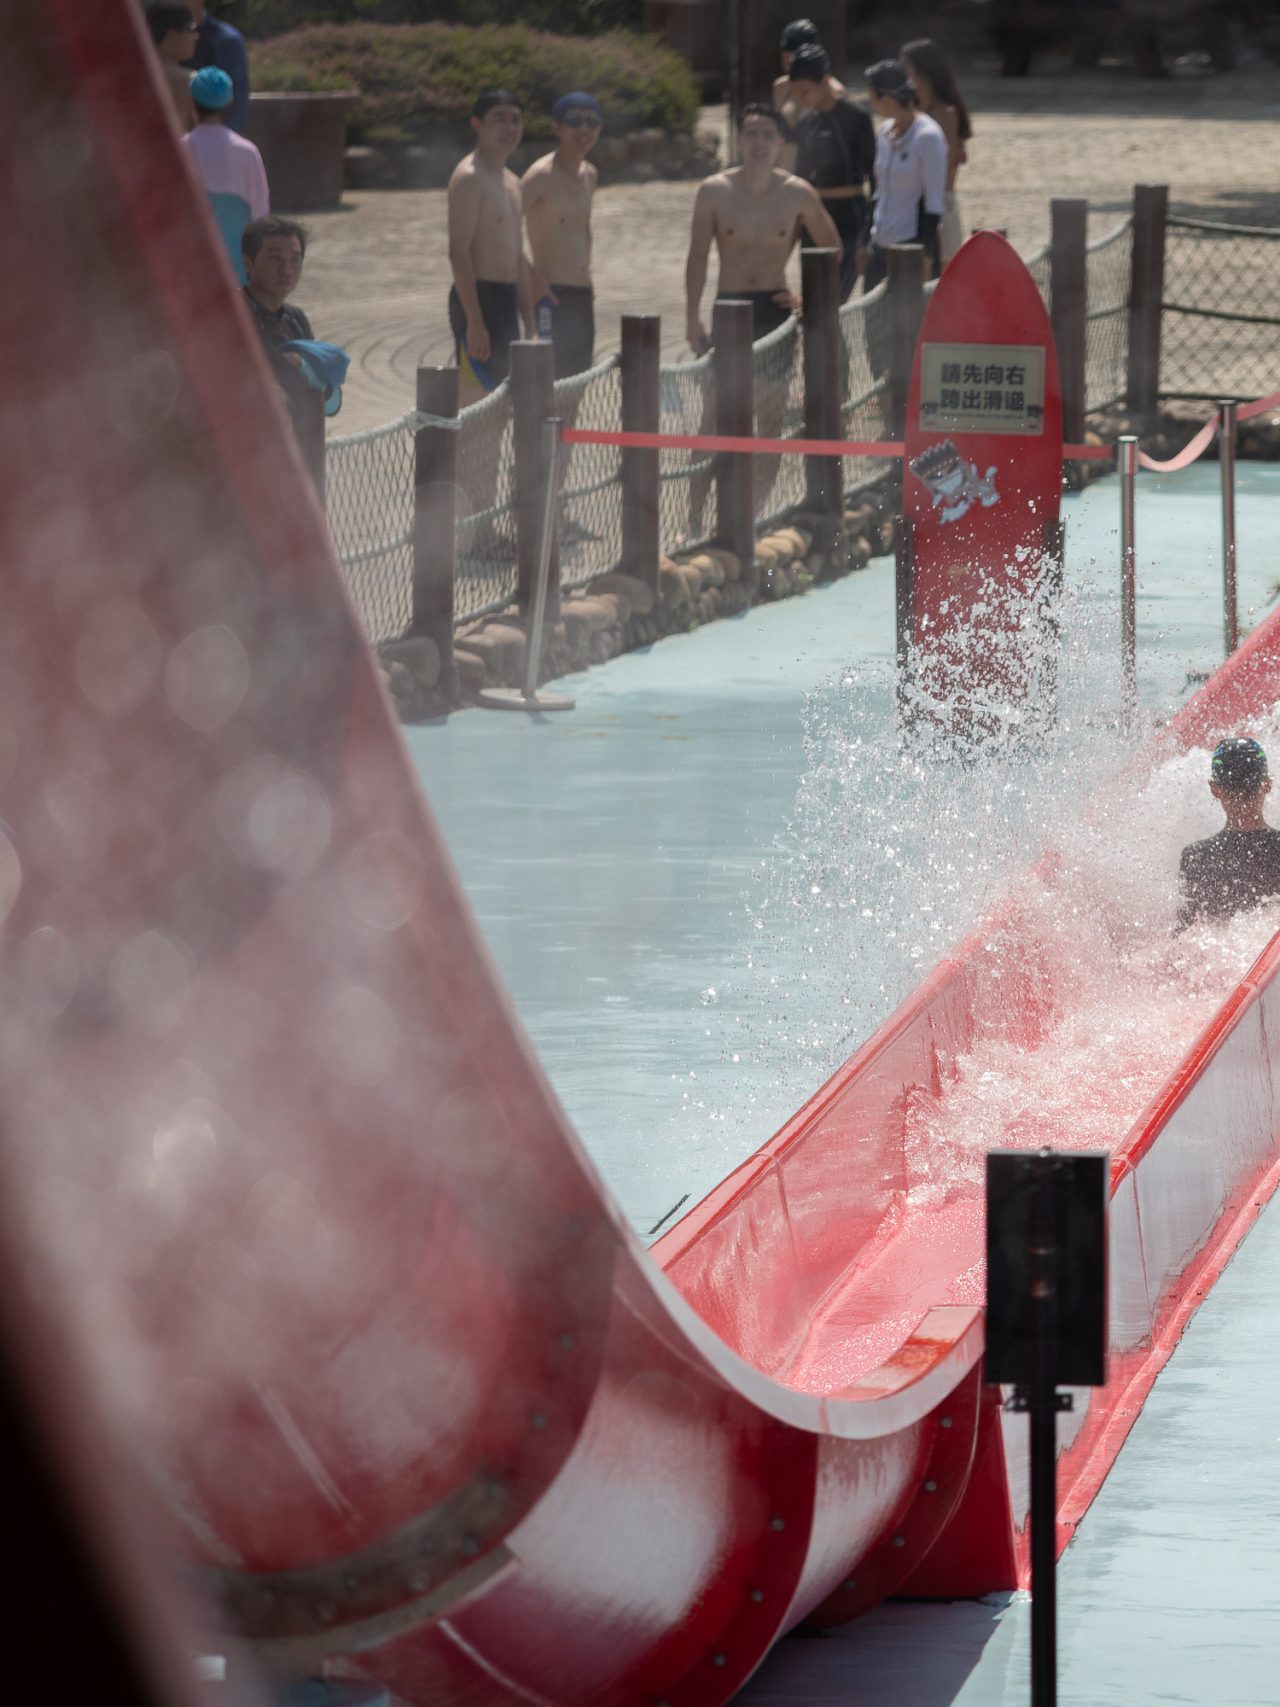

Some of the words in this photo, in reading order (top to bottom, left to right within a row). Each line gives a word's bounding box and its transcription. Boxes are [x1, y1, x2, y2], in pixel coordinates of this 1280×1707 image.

[941, 363, 1026, 385] 請先向右
[940, 388, 1025, 412] 跨出滑道
